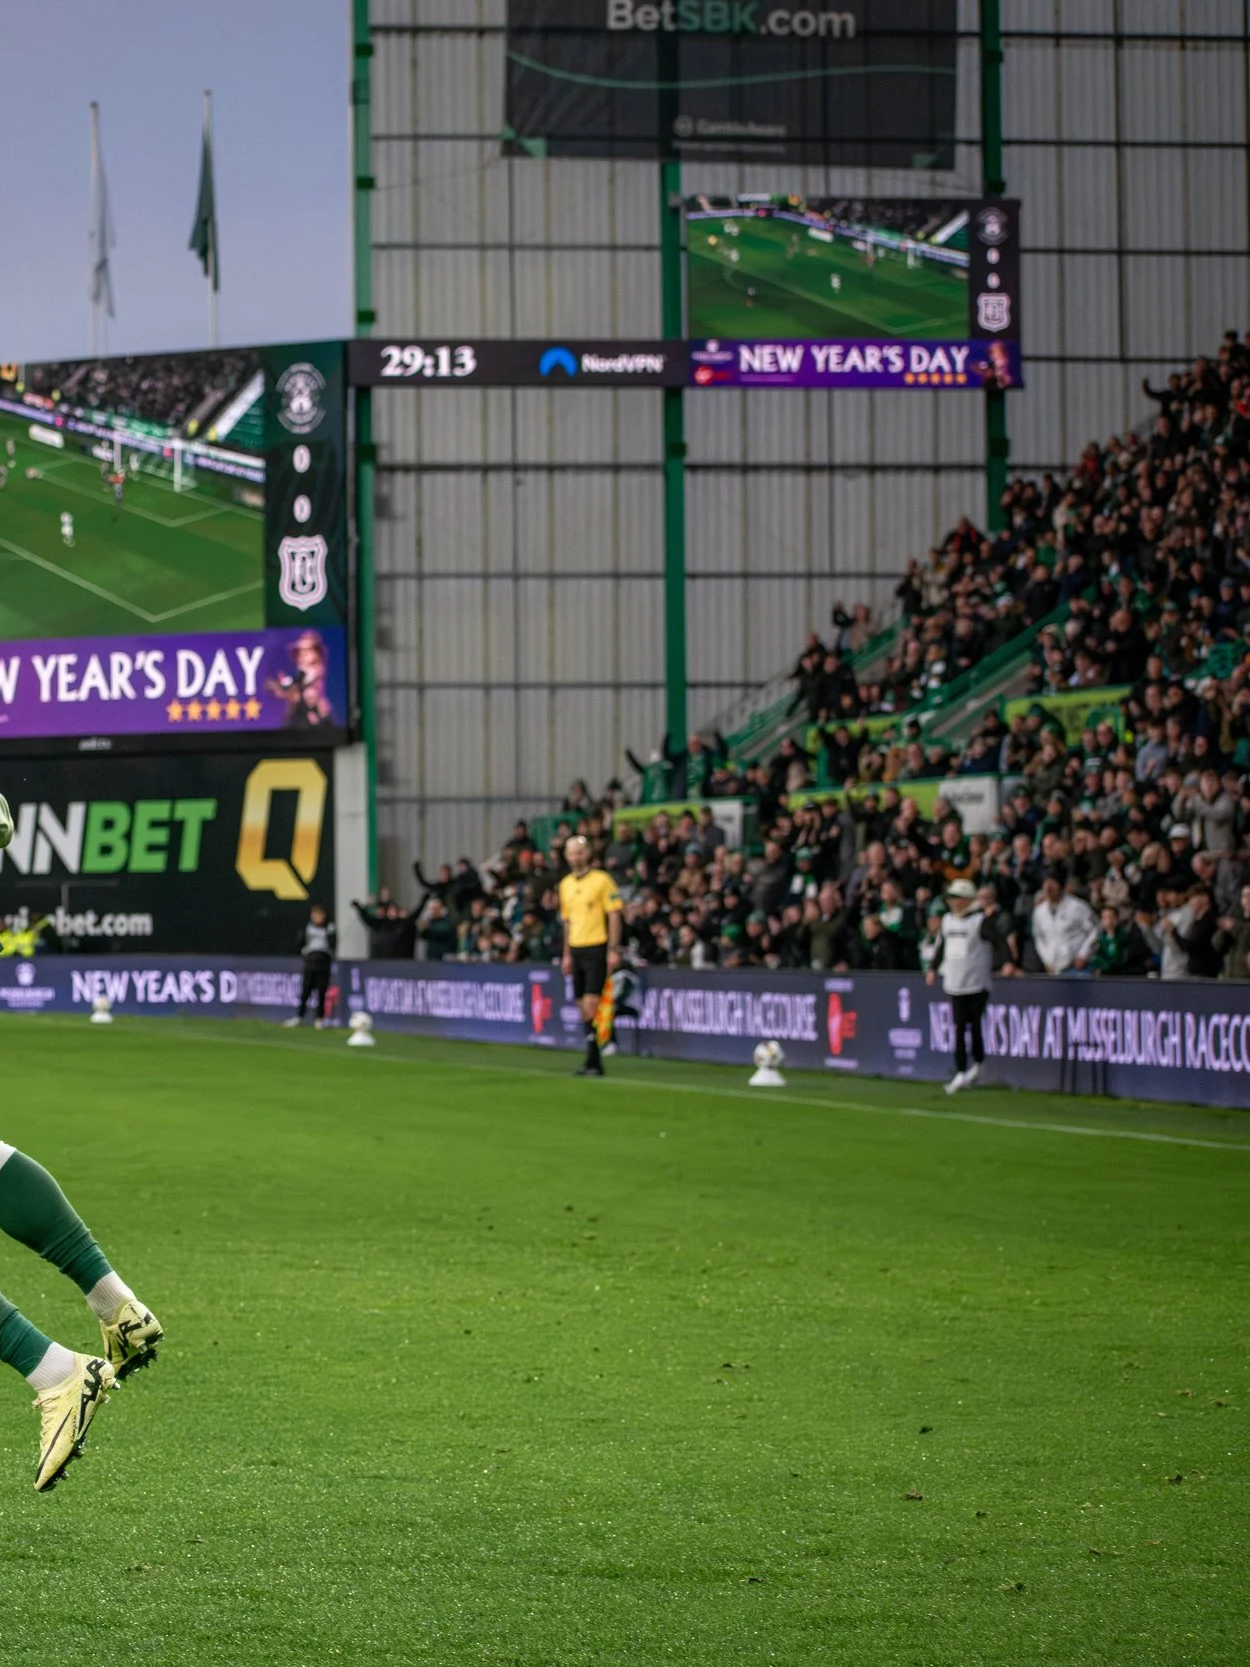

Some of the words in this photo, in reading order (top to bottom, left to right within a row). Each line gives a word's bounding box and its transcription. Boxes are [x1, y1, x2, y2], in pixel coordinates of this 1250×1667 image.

[607, 0, 856, 38] BetSBK.com
[380, 345, 477, 377] 29:13
[739, 345, 804, 373] NEW
[810, 345, 904, 373] YEAR'S
[910, 346, 970, 373] DAY
[293, 444, 312, 474] 0
[293, 494, 312, 523] 0
[30, 651, 166, 702] YEAR'S
[176, 646, 265, 697] DAY
[235, 758, 328, 900] Q
[71, 970, 130, 1003] NEW
[131, 970, 215, 1003] YEAR'S
[1009, 1004, 1042, 1058] DAY
[1043, 1005, 1065, 1060] AT
[1066, 1006, 1182, 1068] MUSSELBURGH
